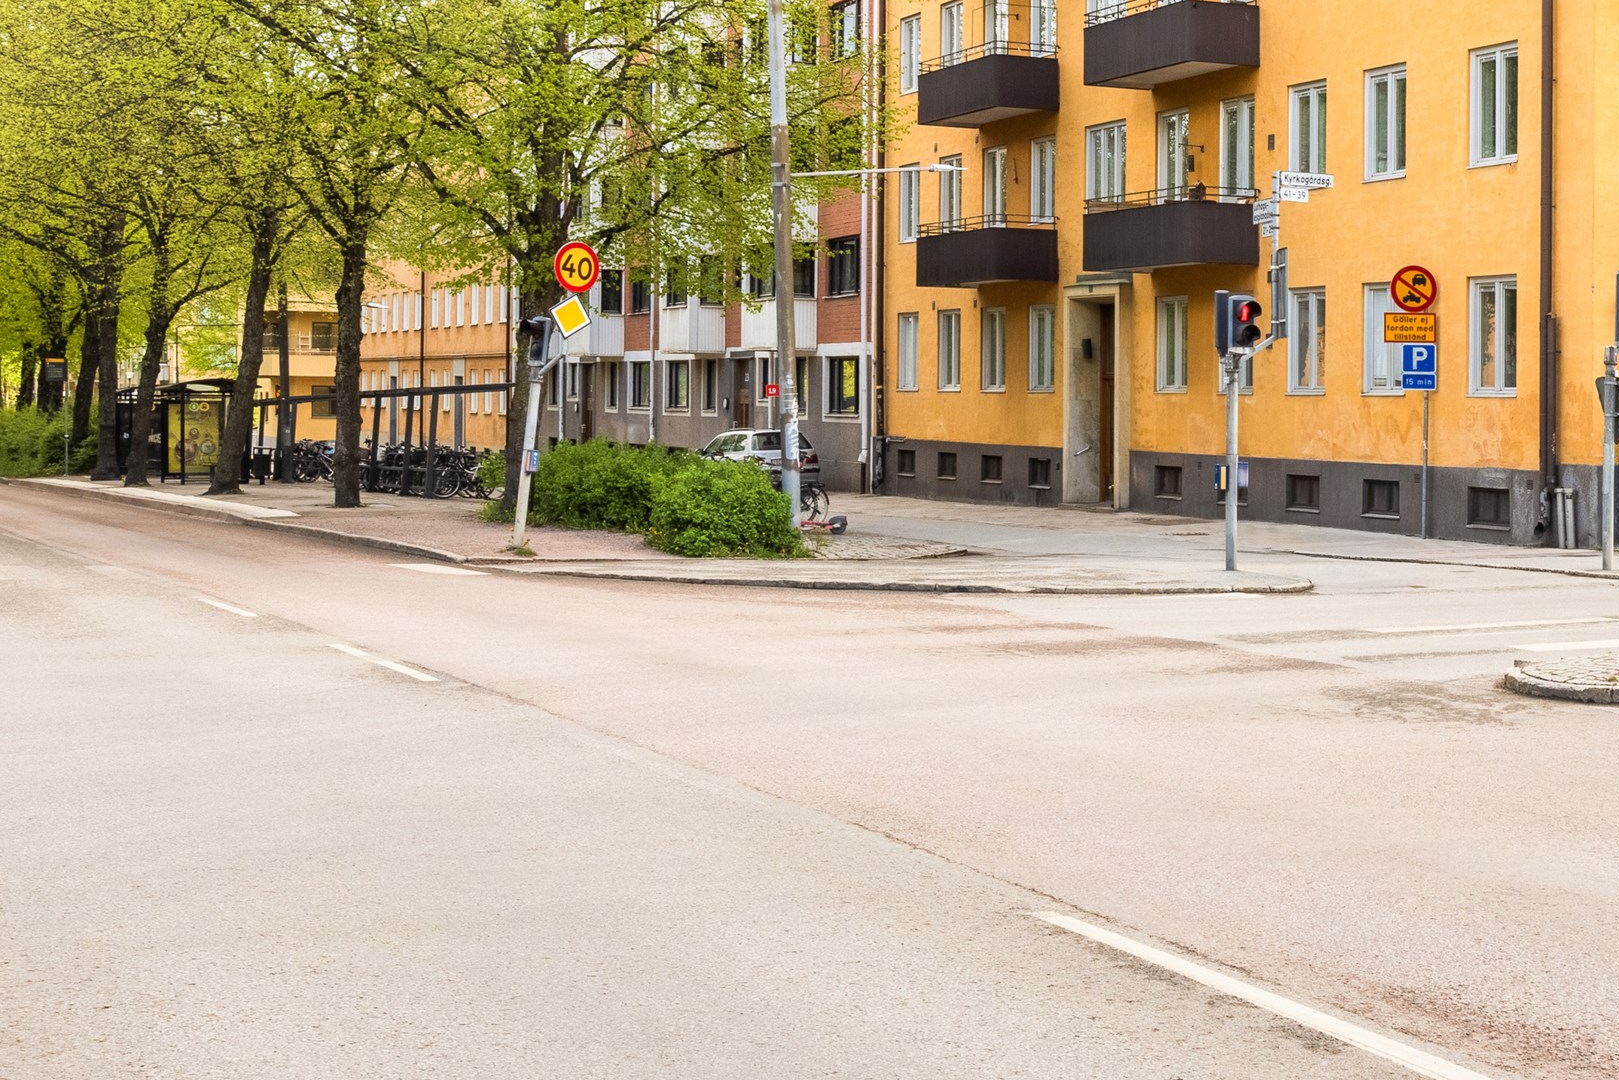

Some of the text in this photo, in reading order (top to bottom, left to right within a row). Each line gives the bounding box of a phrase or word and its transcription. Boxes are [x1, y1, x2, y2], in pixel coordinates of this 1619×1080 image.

[1284, 174, 1332, 186] Kyrkogårdsg.
[562, 254, 592, 280] 40
[1393, 315, 1428, 325] Gäller ej
[1394, 333, 1427, 341] tillstånd
[1412, 347, 1428, 370] P
[1405, 378, 1432, 386] 15 min
